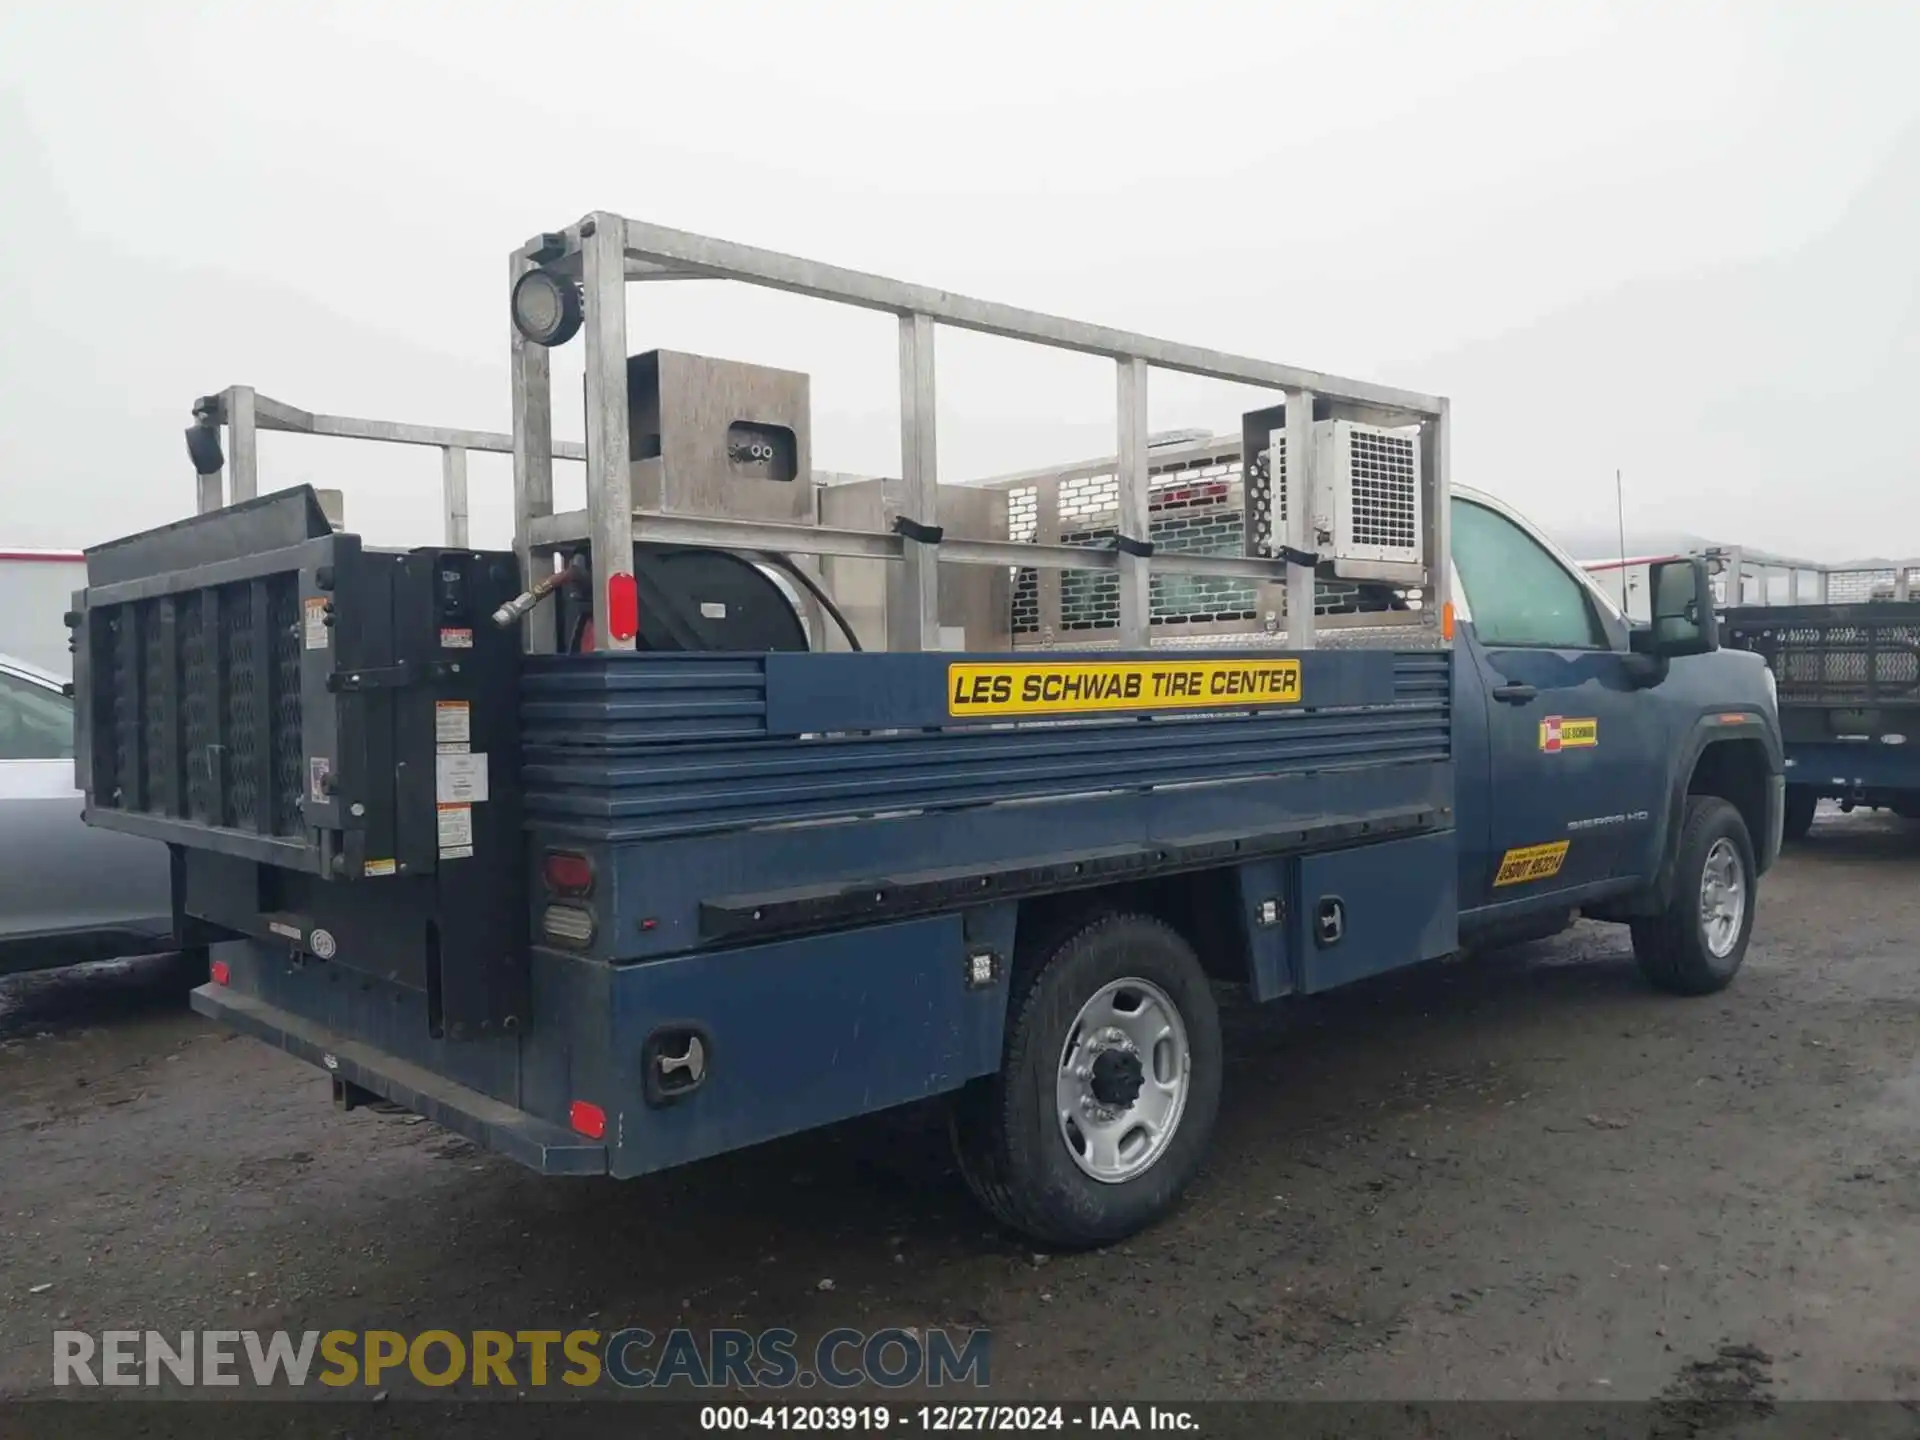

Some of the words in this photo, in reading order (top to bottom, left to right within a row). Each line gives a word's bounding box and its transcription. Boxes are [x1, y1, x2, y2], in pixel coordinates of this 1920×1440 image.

[954, 675, 1012, 704] LES
[1021, 673, 1142, 701] SCHWAB
[1152, 671, 1203, 697] TIRE
[1210, 669, 1297, 695] CENTER
[1567, 814, 1625, 830] SIERRA
[1626, 811, 1648, 821] HD
[1498, 859, 1532, 881] USDOT
